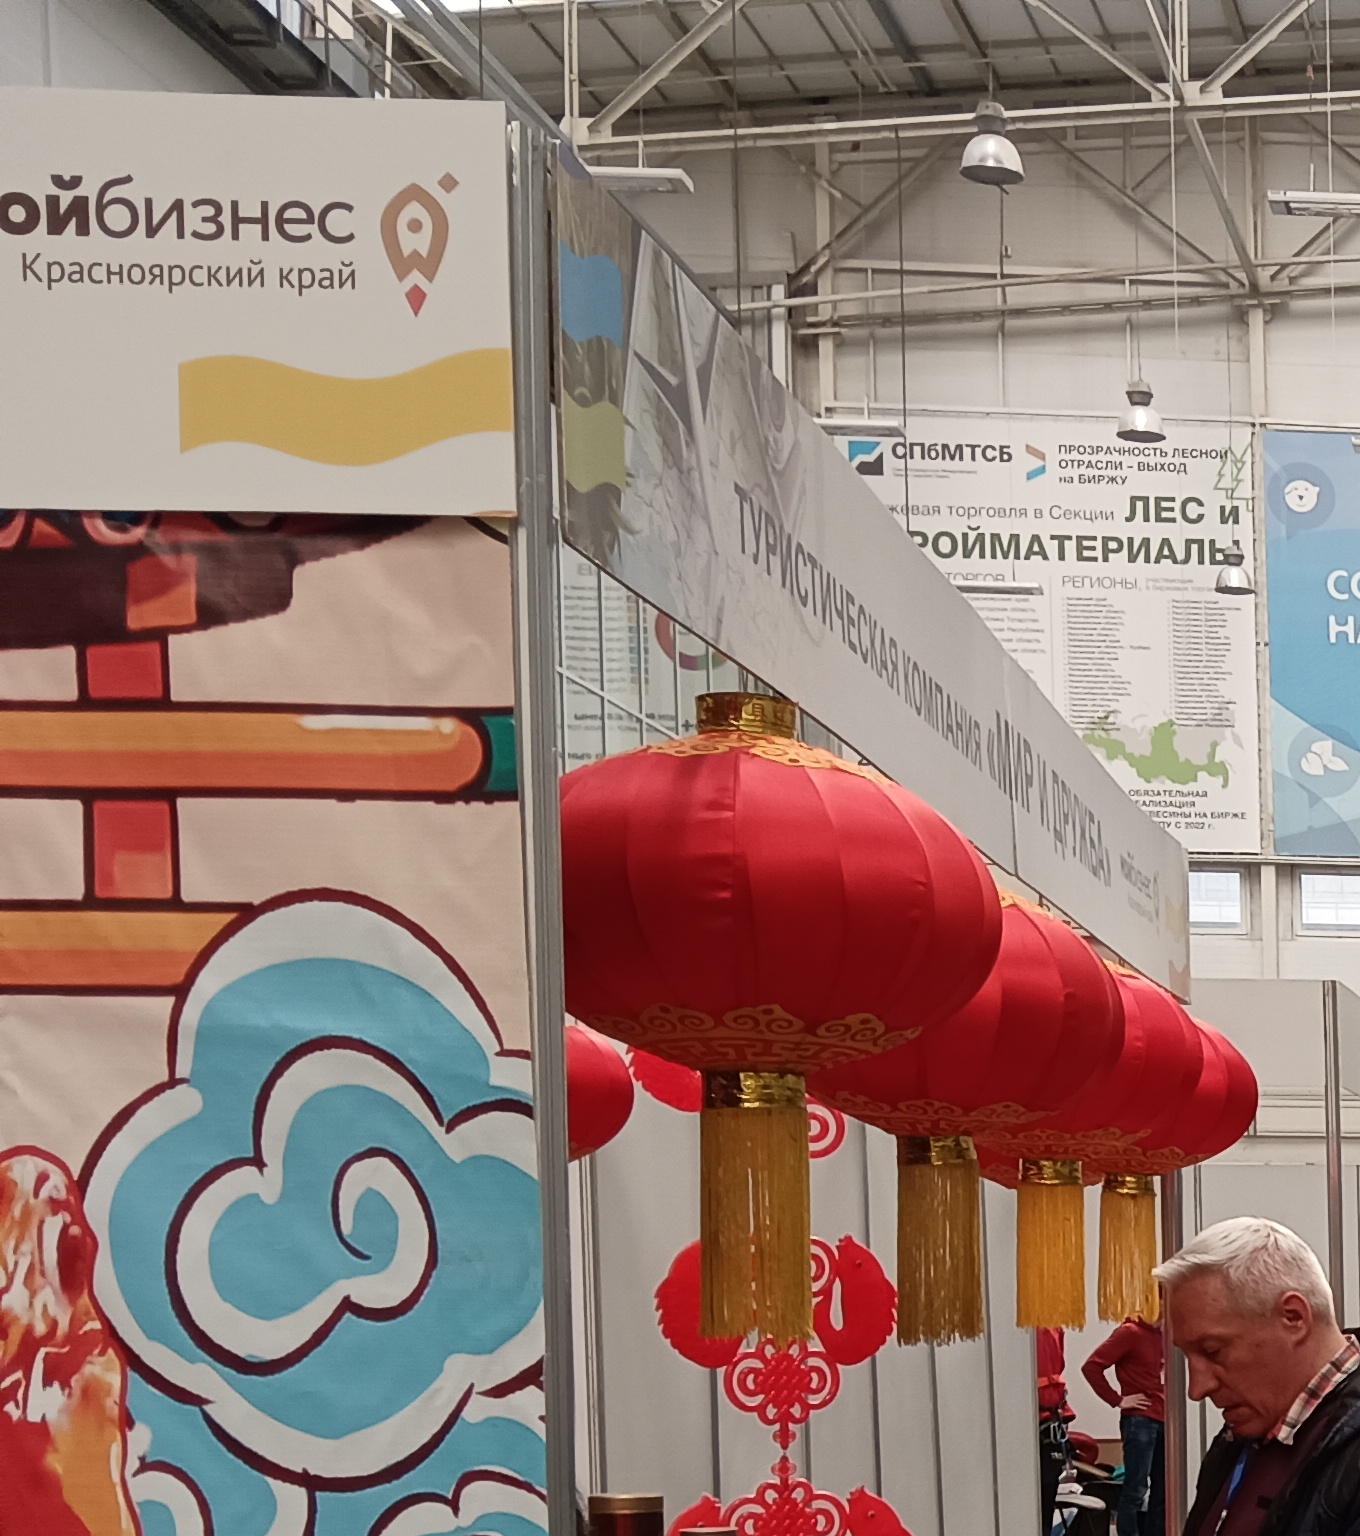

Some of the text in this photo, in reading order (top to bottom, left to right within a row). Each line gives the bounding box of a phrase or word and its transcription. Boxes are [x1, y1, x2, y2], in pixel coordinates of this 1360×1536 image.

[21, 251, 357, 298] Красноярский край
[891, 441, 1013, 463] СПбМТСБ
[1058, 444, 1229, 460] ПРОЗРАЧНОСТЬ ЛЕСНОЙ
[1058, 459, 1123, 472] ОТРАСЛИ
[1137, 460, 1188, 475] ВЫХОД
[1078, 474, 1128, 486] БИРЖУ
[948, 504, 1028, 521] торговля
[1034, 509, 1043, 519] в
[1049, 504, 1115, 522] Секции
[1124, 495, 1206, 525] ЛЕС
[1219, 505, 1241, 526] и
[734, 482, 900, 697] ТУРИСТИЧЕСКАЯ
[903, 653, 983, 774] КОМПАНИЯ
[986, 708, 1036, 815] «МИР
[1037, 764, 1052, 836] И
[1051, 773, 1112, 888] ДРУЖБА»
[1128, 788, 1208, 798] ОБЯЗАТЕЛЬНАЯ
